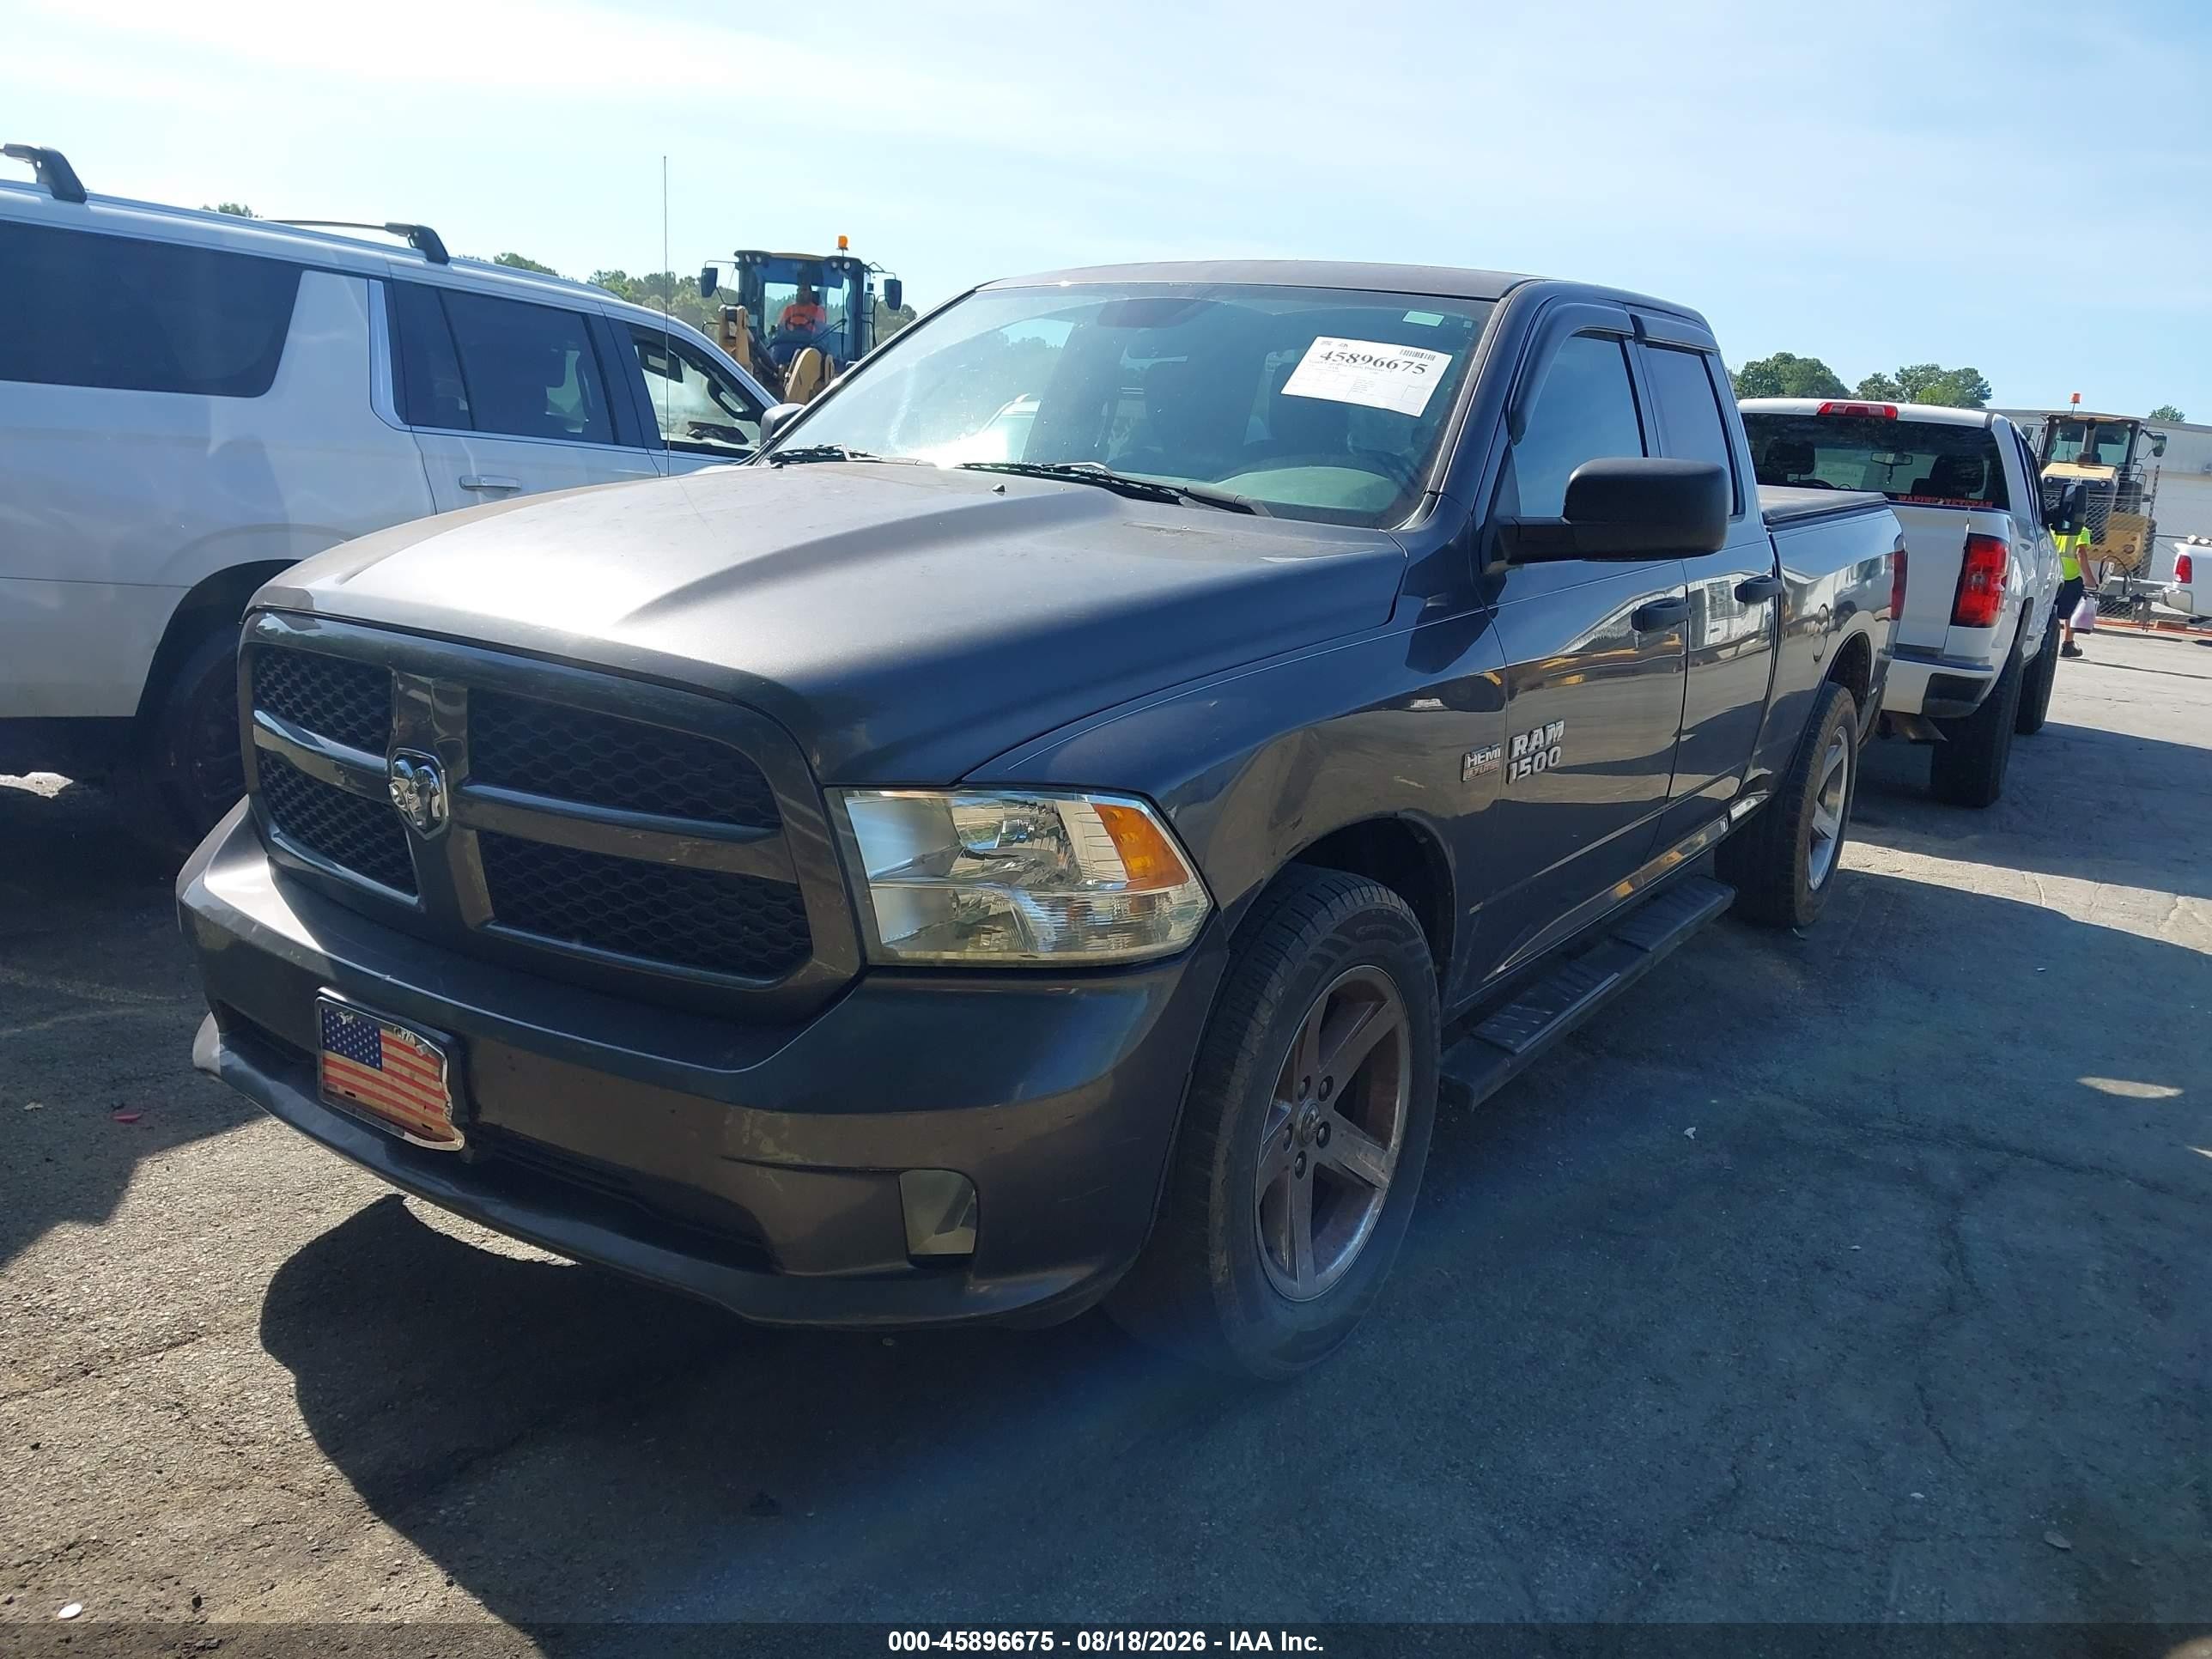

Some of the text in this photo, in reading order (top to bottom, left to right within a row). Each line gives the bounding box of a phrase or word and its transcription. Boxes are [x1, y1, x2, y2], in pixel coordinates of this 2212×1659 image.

[1320, 350, 1428, 374] 45896675
[1510, 720, 1565, 759] RAM
[1467, 746, 1501, 767] HEMI
[1507, 745, 1561, 785] 1500
